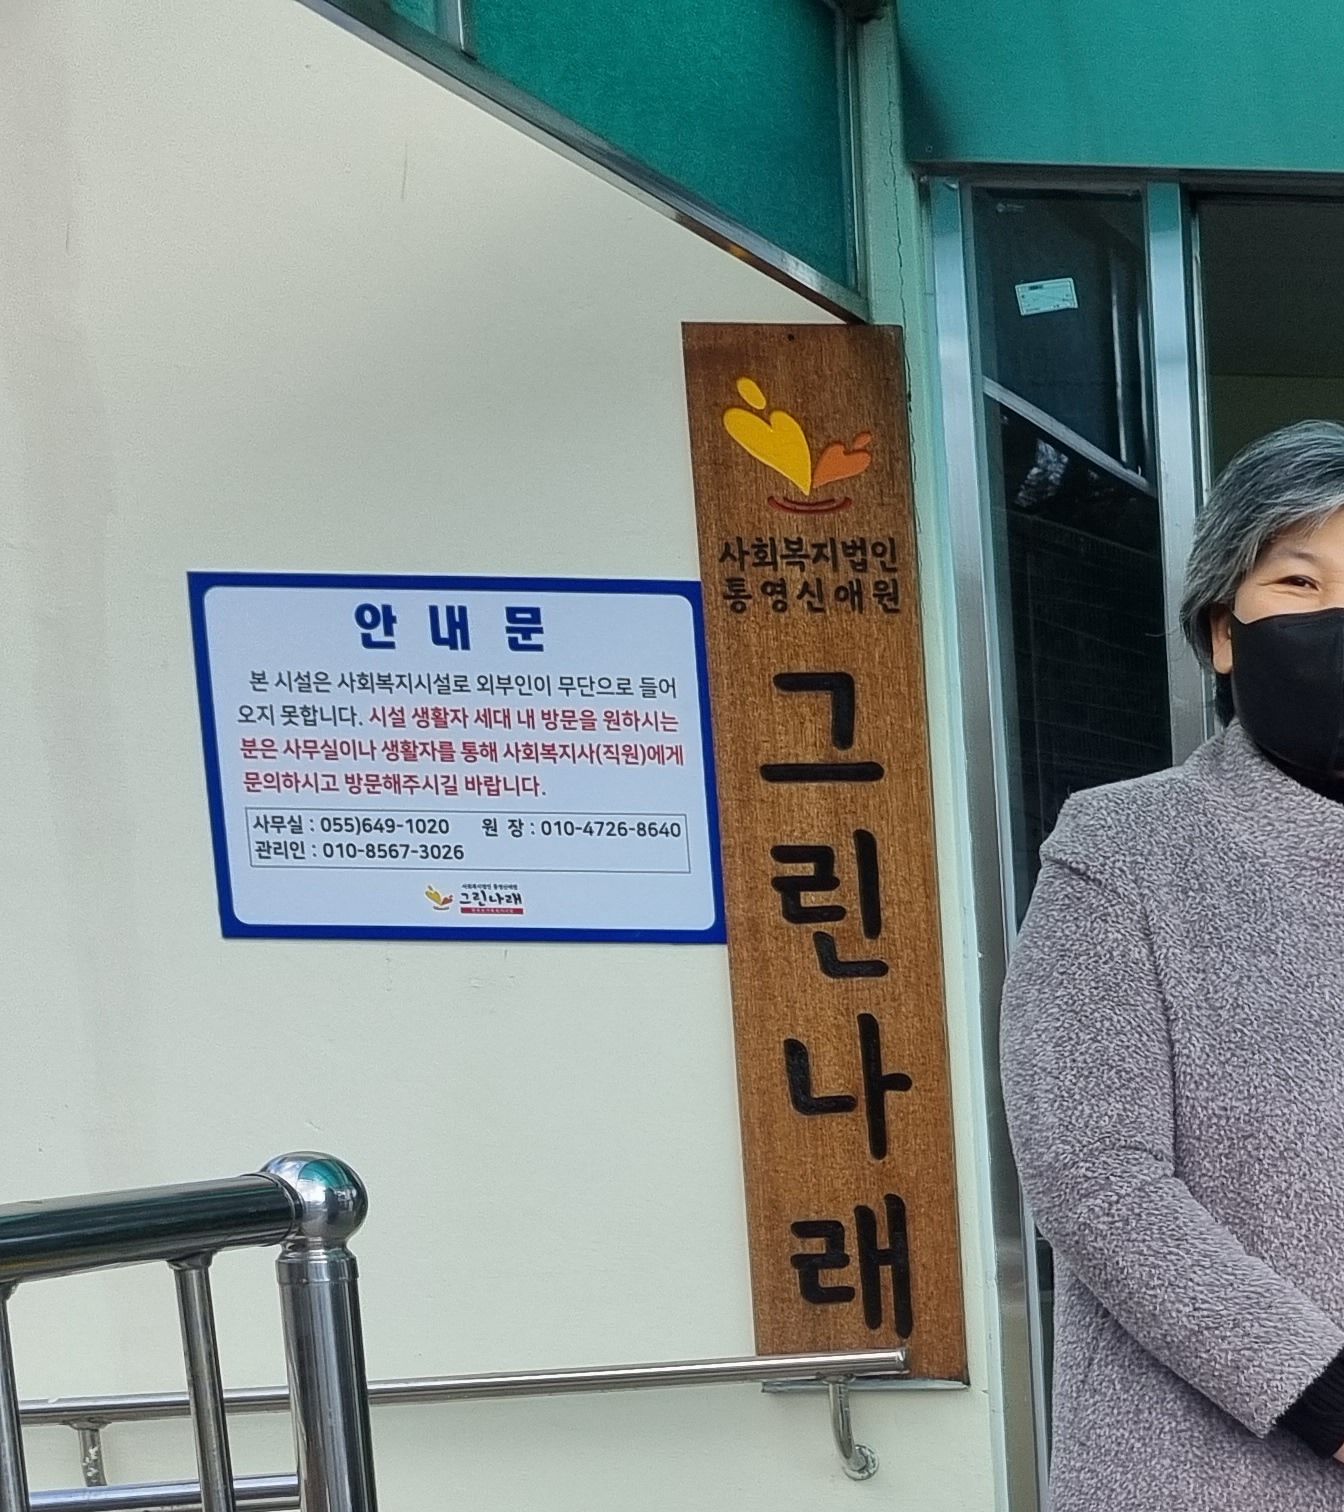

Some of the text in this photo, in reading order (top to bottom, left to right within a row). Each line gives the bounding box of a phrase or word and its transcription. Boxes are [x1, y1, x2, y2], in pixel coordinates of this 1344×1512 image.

[718, 536, 898, 574] 사회복지법인
[250, 671, 676, 698] 본 시설은 사회복지시설로 외부인이 무단으로 들어
[237, 705, 679, 732] 오지 못합니다. 시설 생활자 세대 내 방문을 원하시는
[240, 738, 683, 766] 분은 사무실이나 생활자를 통해 사회복지사(직원)에게
[243, 772, 546, 797] 문의하시고 방문해주시길 바랍니다.
[253, 815, 303, 834] 사무실
[321, 817, 449, 835] 055)649-1020
[541, 821, 681, 837] 010-4726-8640
[255, 840, 305, 859] 관리인
[323, 843, 464, 860] 010-8567-3026
[459, 890, 522, 906] 그린나래
[760, 671, 913, 1339] 그린나래
